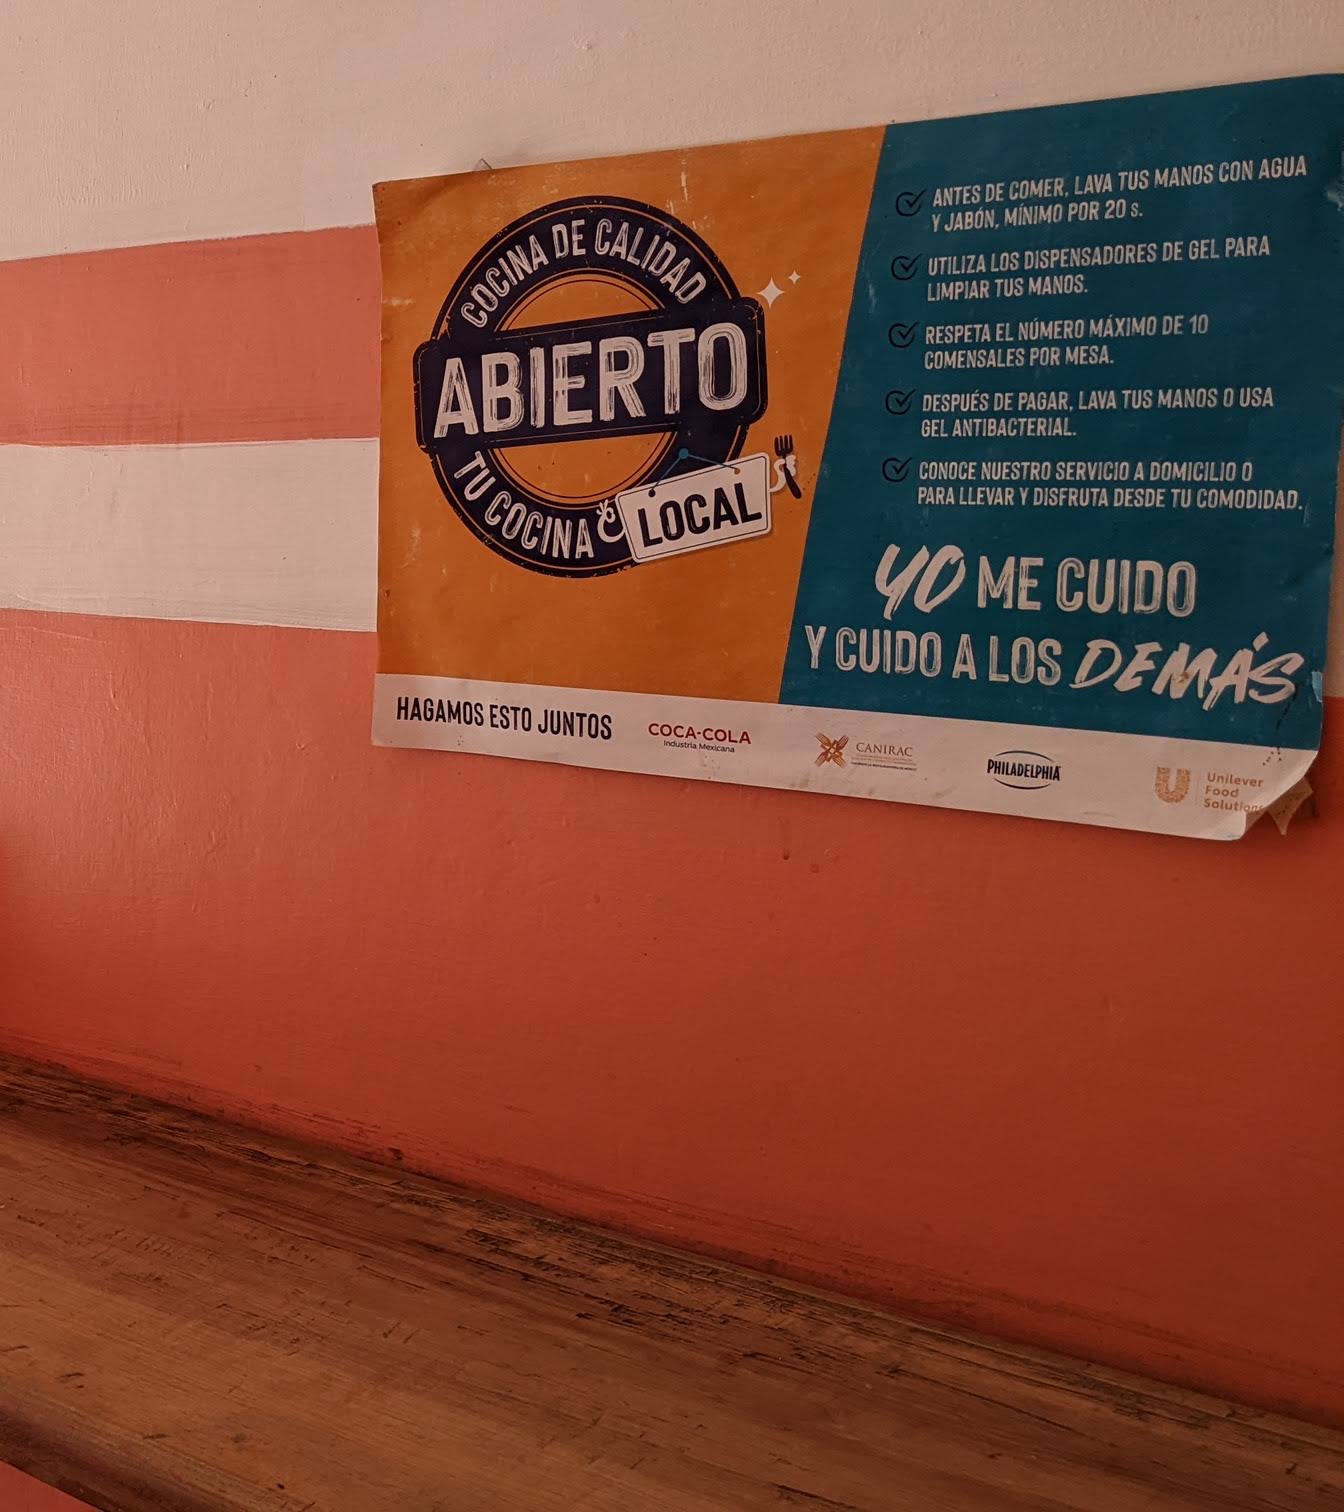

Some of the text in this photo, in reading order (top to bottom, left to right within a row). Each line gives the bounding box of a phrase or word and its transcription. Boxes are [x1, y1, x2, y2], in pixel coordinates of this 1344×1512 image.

[933, 155, 1307, 207] ANTES DE COMER, LAVA TUS MANOS CON AGUA
[931, 215, 940, 232] Y
[944, 207, 999, 230] JABÓN,
[1004, 203, 1062, 227] MÍNIMO
[1068, 202, 1098, 221] POR
[1105, 200, 1126, 218] 20
[928, 236, 1270, 275] UTILIZA LOS DISPENSADORES DE GEL PARA
[461, 219, 706, 328] COCINA DE CALIDAD
[928, 275, 1087, 301] LIMPIAR TUS MANOS.
[925, 314, 1208, 344] RESPETA EL NÚMERO MÁXIMO DE 10
[924, 346, 1114, 370] COMENSALES POR MESA.
[433, 322, 748, 440] ABIERTO
[922, 387, 1273, 412] DESPUÉS DE PAGAR, LAVA TUS MANOS O USA
[921, 417, 1076, 437] GEL ANTIBACTERIAL.
[919, 462, 1252, 481] CONOCE NUESTRO SERVICIO A DOMICILIO O
[454, 451, 594, 559] TU COCINA
[918, 487, 1302, 510] PARA LLEVAR Y DISFRUTA DESDE TU COMODIDAD.
[637, 482, 761, 548] LOCAL
[875, 543, 1196, 620] YO ME CUIDO
[805, 625, 1304, 711] Y CUIDO A LOS DEMÁS
[397, 697, 612, 740] HAGAMOS ESTO JUNTOS
[648, 723, 751, 744] COCA-COLA
[663, 740, 735, 753] Industria Mexicana
[856, 742, 913, 757] CANIRAC
[987, 759, 1061, 781] PHILADELPHIA
[1207, 772, 1264, 787] Unilever
[1206, 785, 1239, 797] Food
